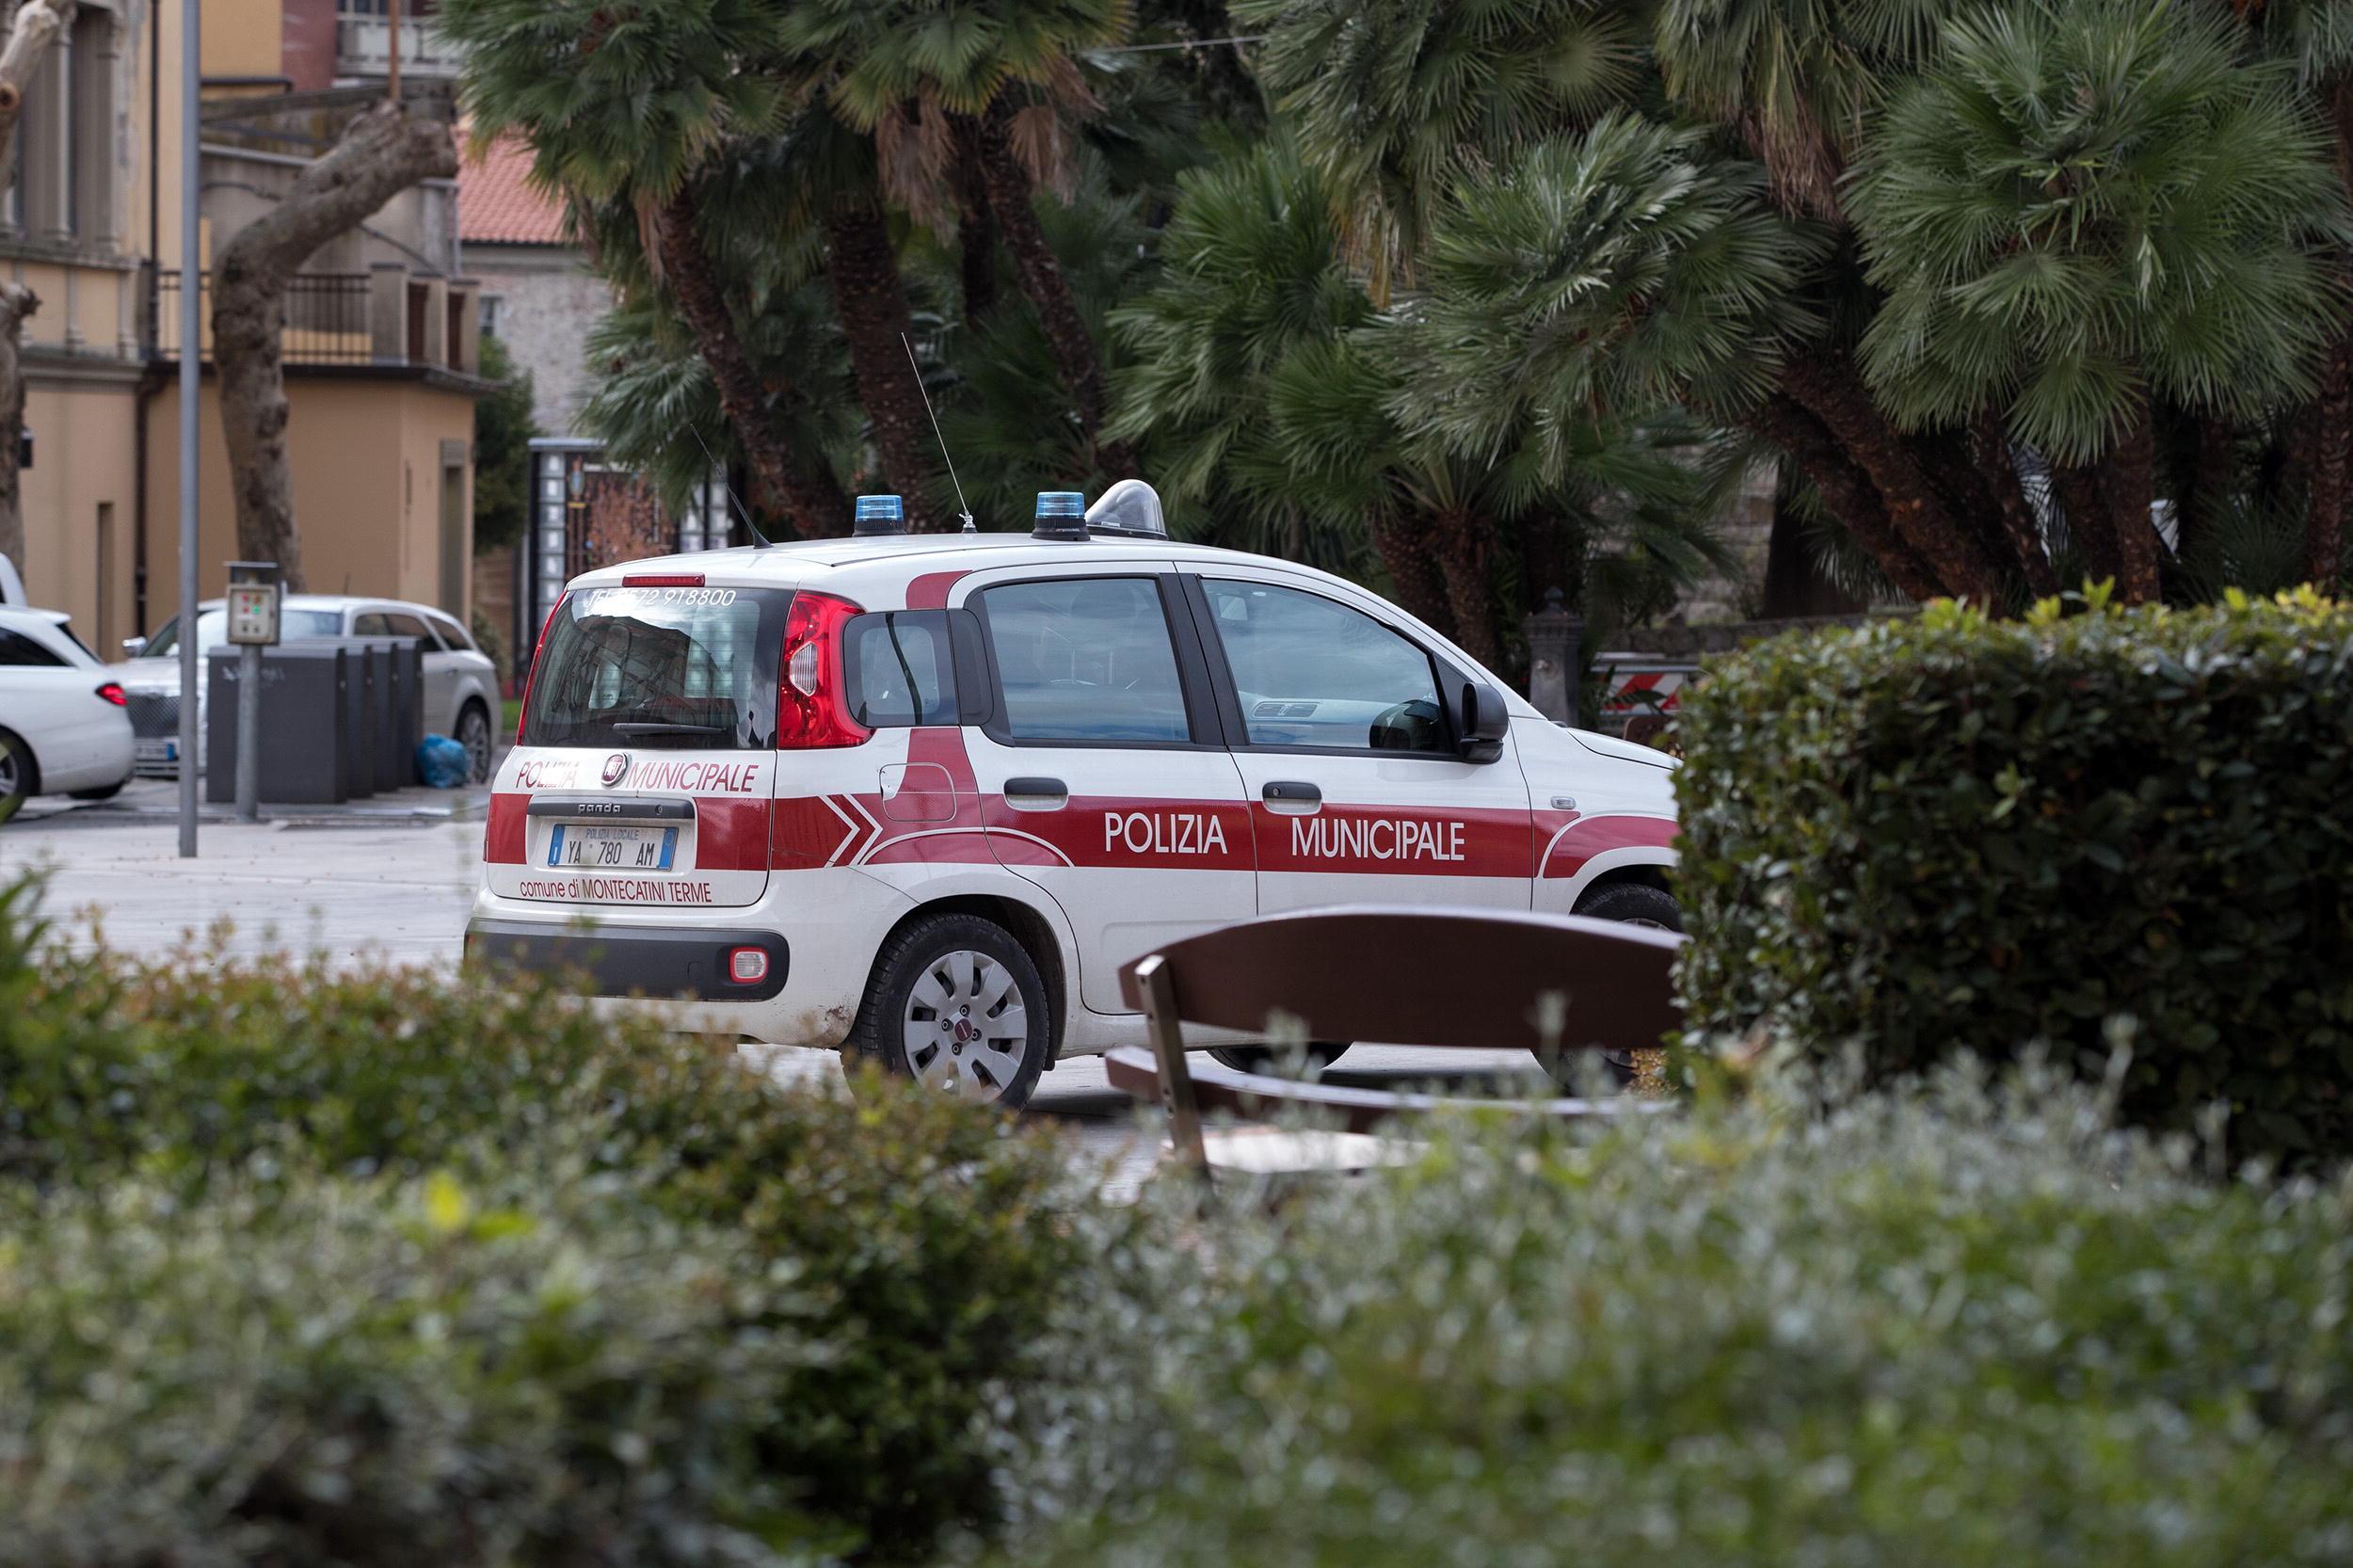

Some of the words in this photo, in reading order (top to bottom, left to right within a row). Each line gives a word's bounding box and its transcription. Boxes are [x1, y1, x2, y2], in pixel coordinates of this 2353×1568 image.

[664, 589, 737, 606] 918800
[516, 760, 580, 789] POZA
[625, 761, 760, 792] MUNICIPALE
[578, 802, 621, 814] panda
[585, 828, 610, 840] POLIZIA
[613, 829, 640, 840] LOCALE
[1105, 812, 1227, 854] POLIZIA
[1291, 817, 1465, 861] MUNICIPALE
[568, 841, 582, 864] YA
[597, 841, 623, 864] 780
[635, 843, 656, 866] AM
[520, 881, 565, 898] comune
[568, 878, 580, 898] di
[582, 879, 666, 901] MONTECATINI
[667, 882, 712, 903] TERME
